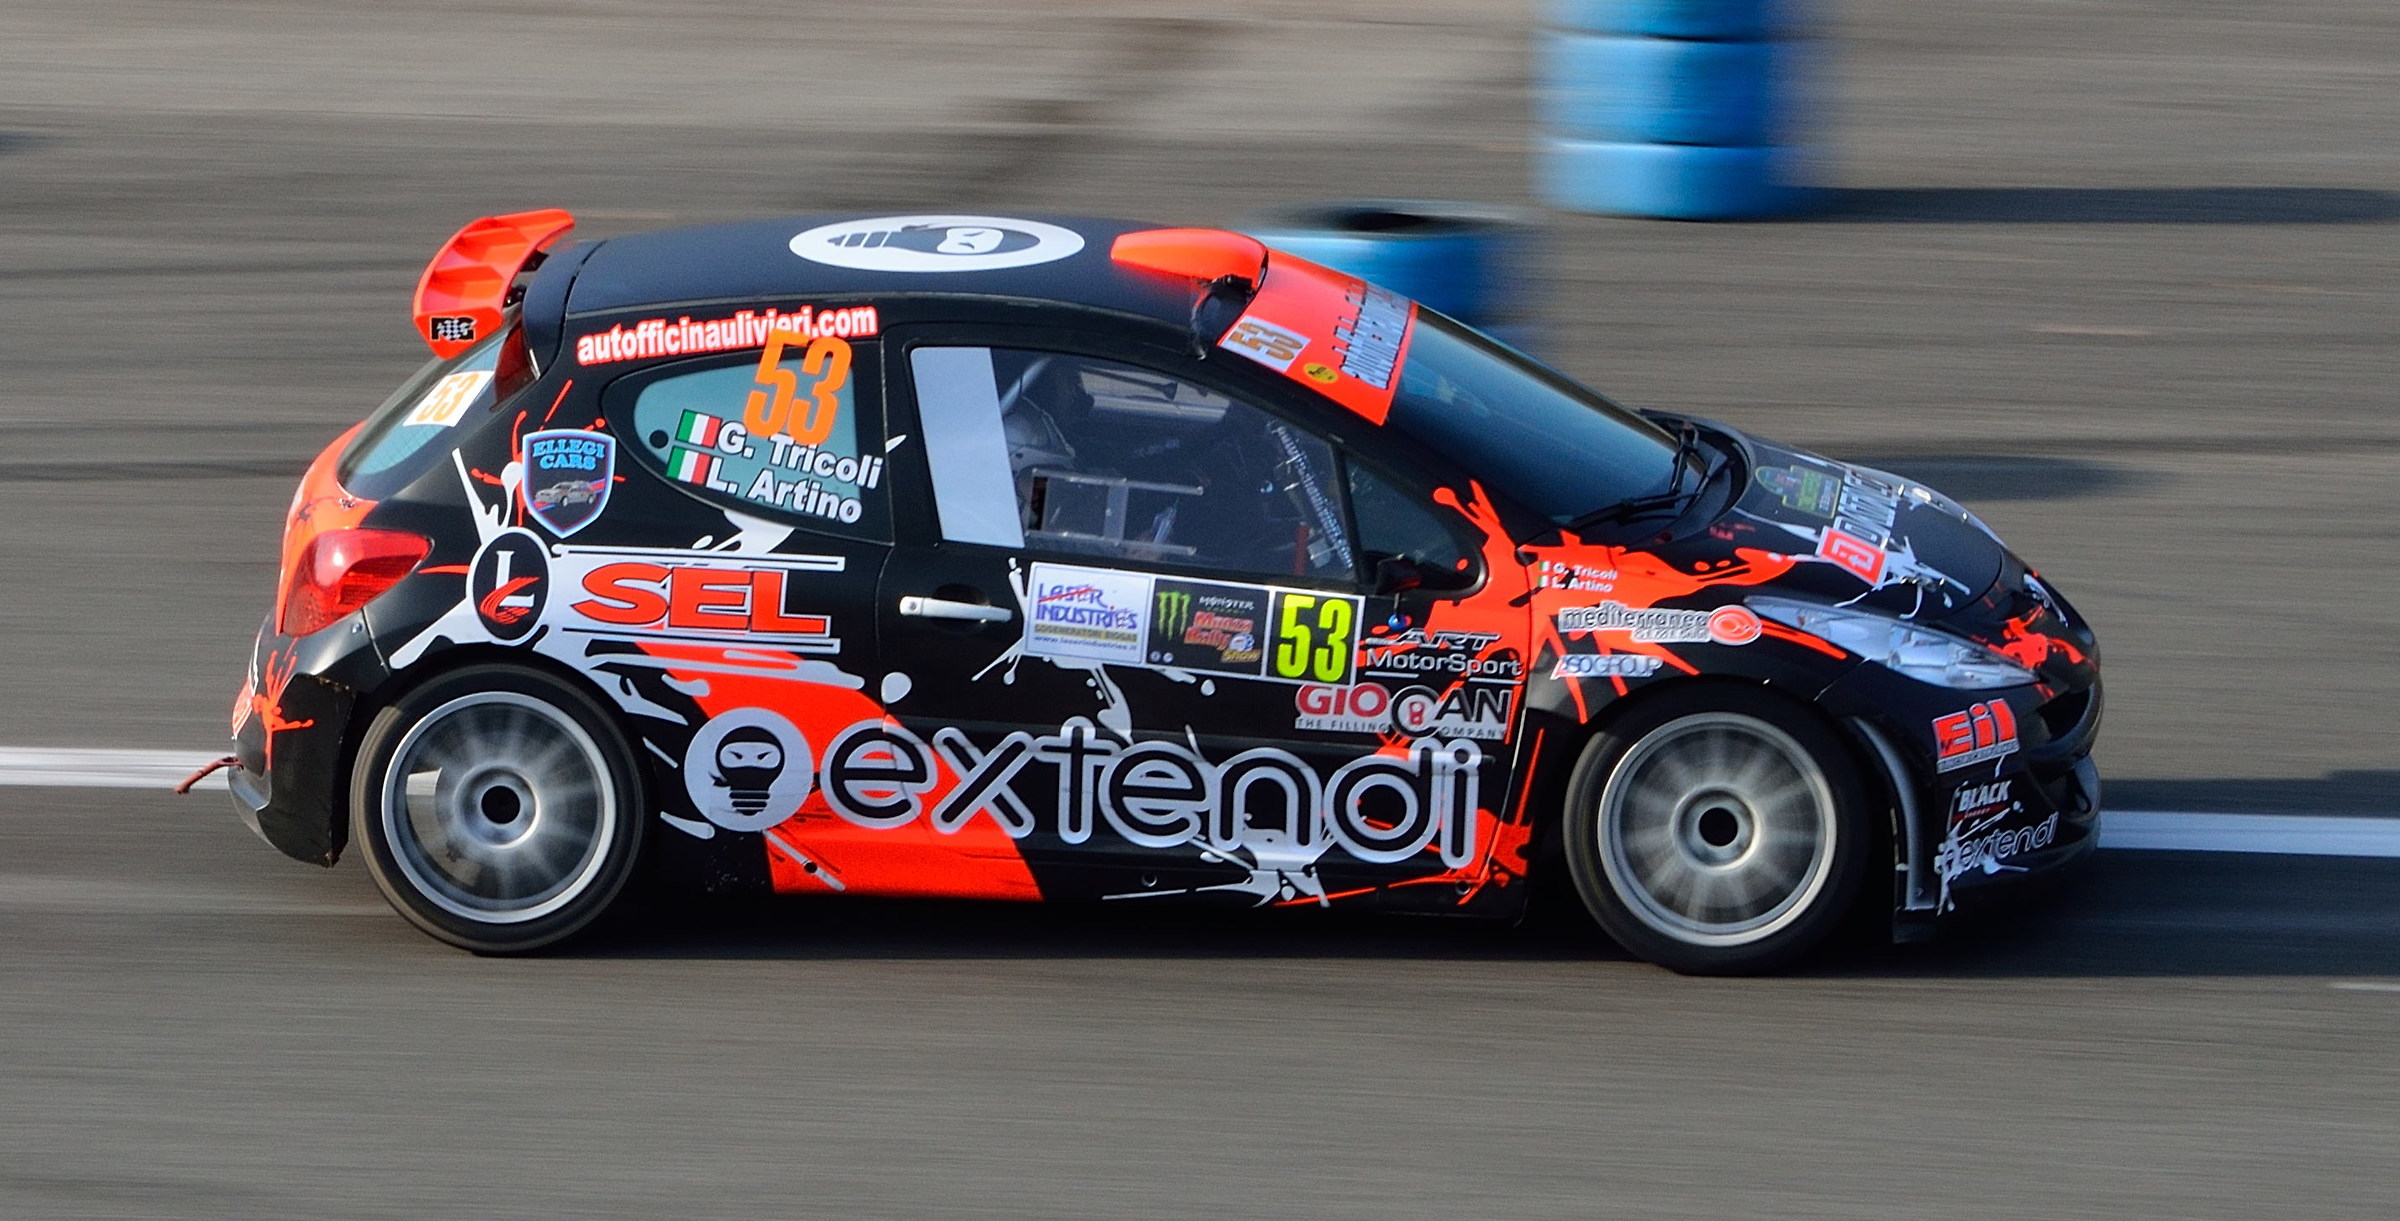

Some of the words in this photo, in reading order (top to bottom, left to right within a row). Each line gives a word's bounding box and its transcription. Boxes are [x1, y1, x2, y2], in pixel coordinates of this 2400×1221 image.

[577, 307, 878, 366] autofficinaulivieri.com
[1230, 322, 1302, 362] 53
[415, 373, 479, 422] 53
[744, 329, 852, 445] 53
[532, 439, 605, 458] ELLEGI
[540, 453, 597, 471] CARS
[717, 421, 755, 459] G.
[769, 432, 883, 490] Tricoli
[705, 456, 739, 495] L.
[747, 467, 862, 524] Artino
[1568, 577, 1614, 593] Artino
[1572, 564, 1618, 580] Tricoli
[571, 561, 832, 636] SEL
[1276, 594, 1352, 683] 53
[1366, 648, 1523, 678] MotorSport
[820, 714, 1481, 869] extendi
[1958, 780, 2012, 812] BLACK
